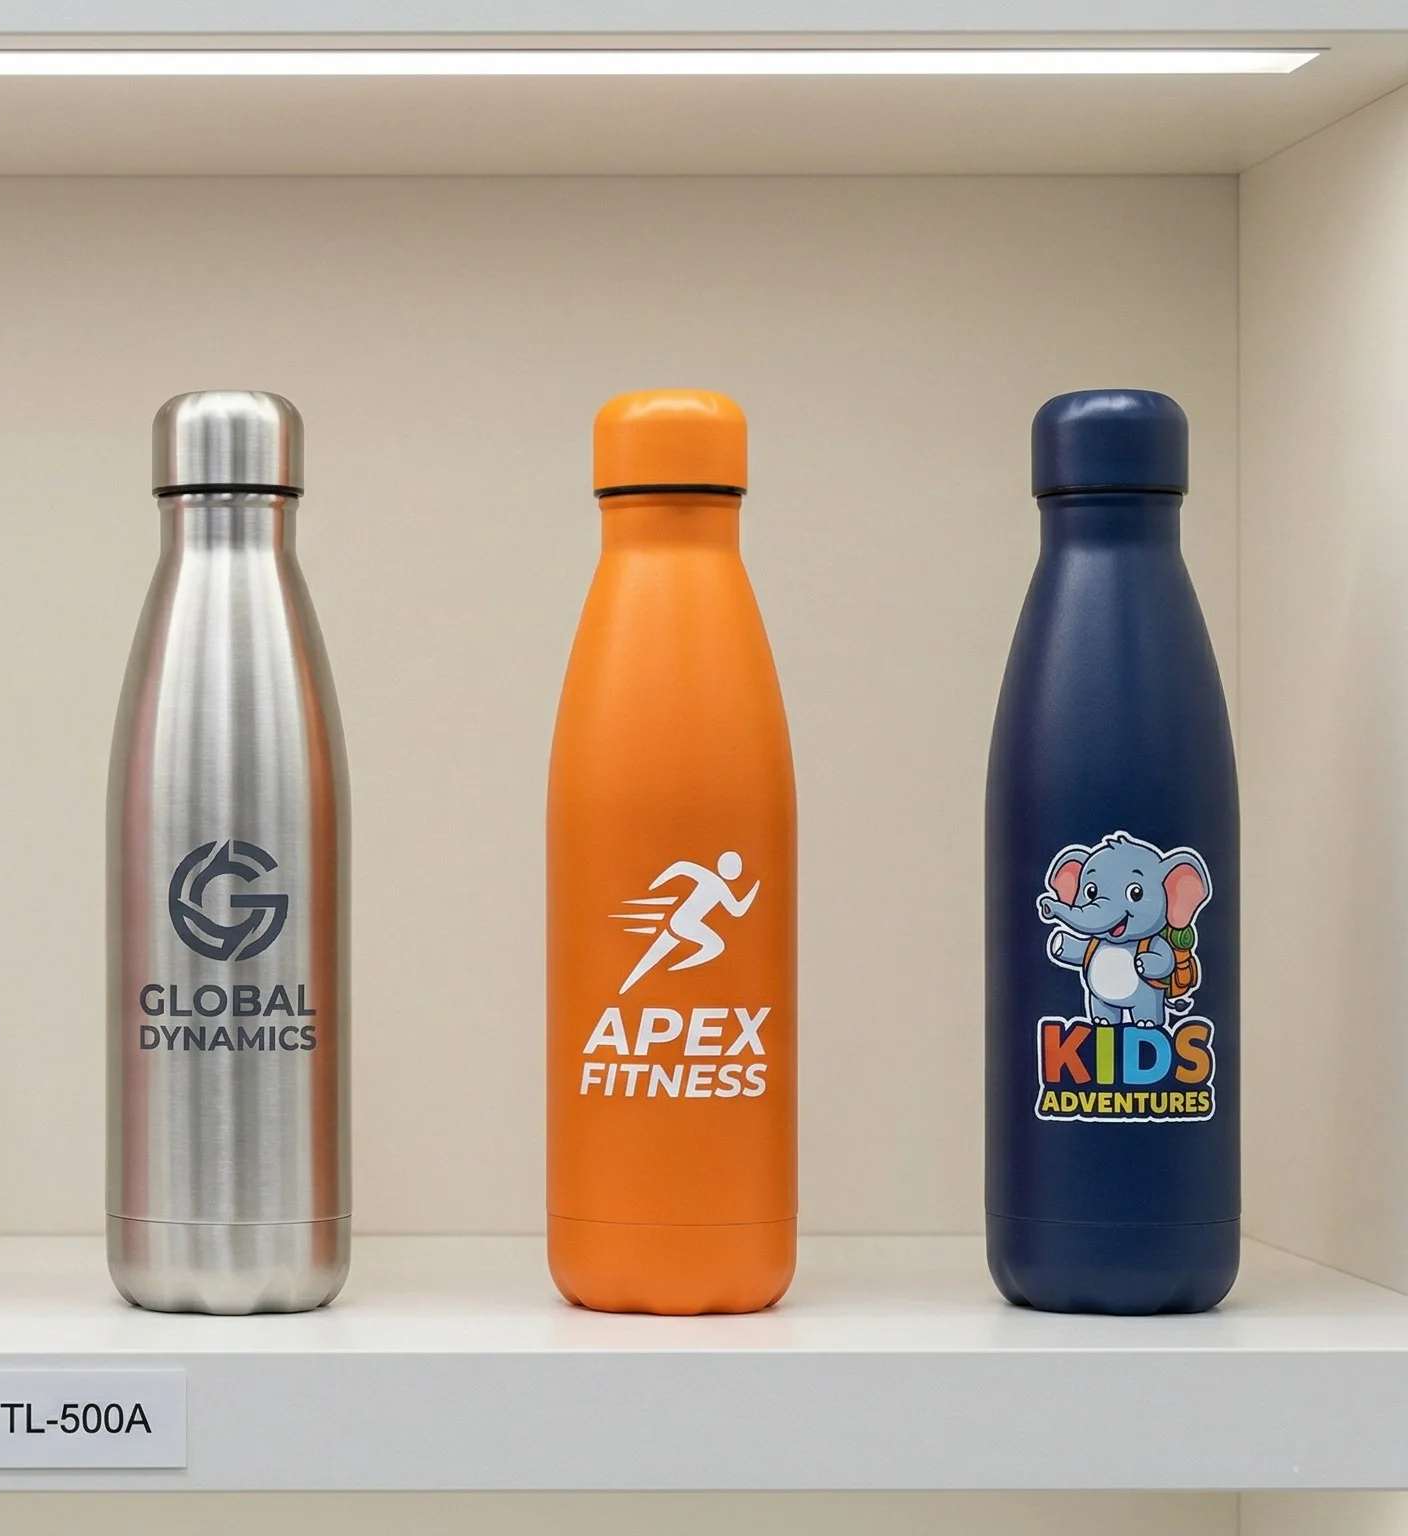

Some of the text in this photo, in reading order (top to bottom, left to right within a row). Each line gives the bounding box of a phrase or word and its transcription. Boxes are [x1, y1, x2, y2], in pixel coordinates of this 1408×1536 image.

[139, 984, 317, 1017] GLOBAL
[139, 1024, 317, 1051] DYNAMICS
[582, 1007, 772, 1056] APEX
[1044, 1025, 1210, 1084] KIDS
[579, 1062, 768, 1098] FITNESS
[1042, 1090, 1210, 1113] ADVENTURES
[0, 1403, 152, 1434] TL-500A
